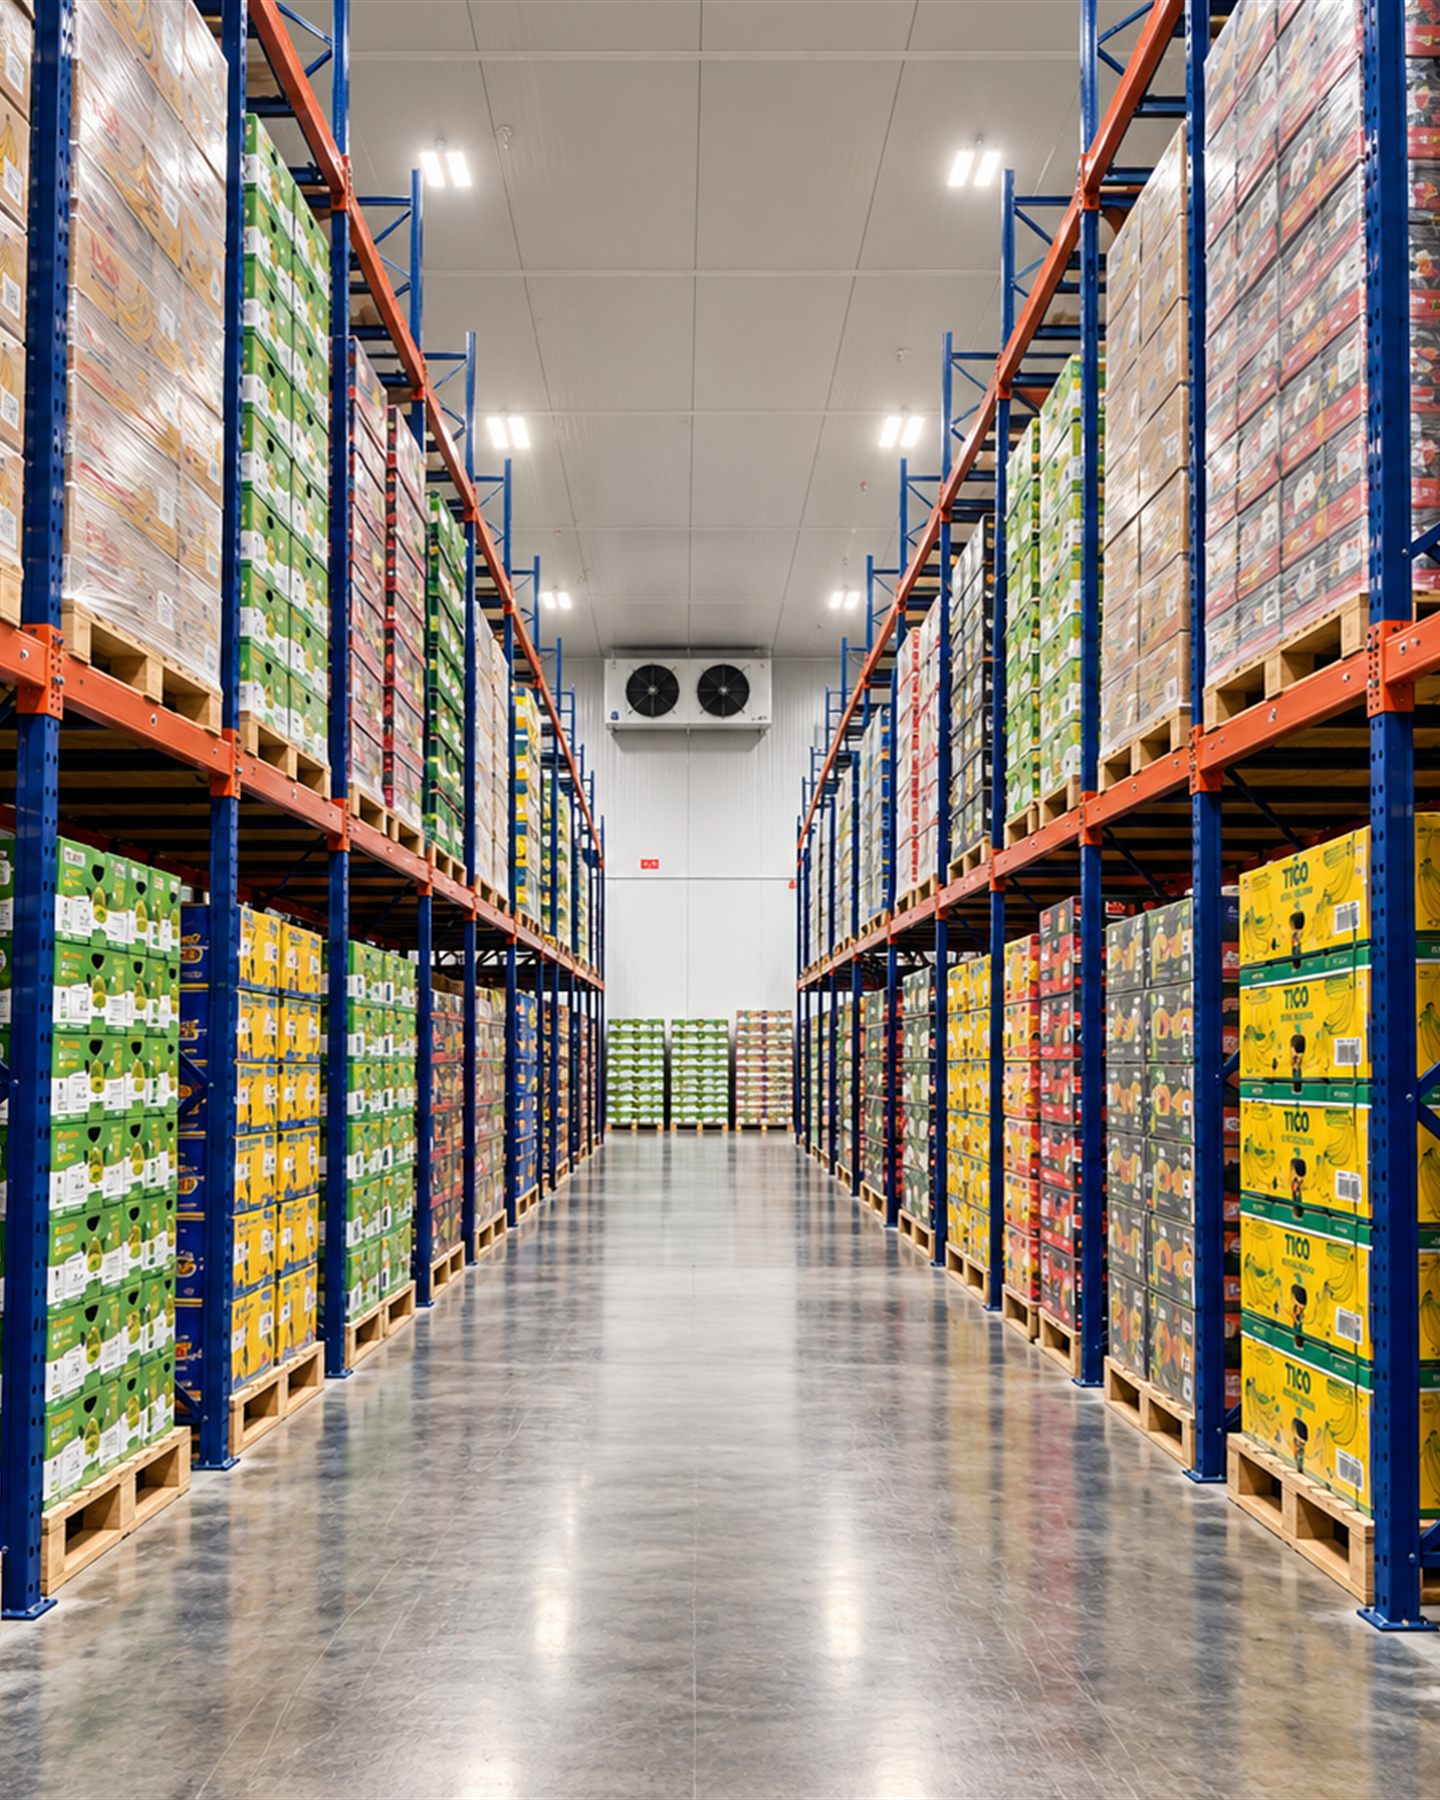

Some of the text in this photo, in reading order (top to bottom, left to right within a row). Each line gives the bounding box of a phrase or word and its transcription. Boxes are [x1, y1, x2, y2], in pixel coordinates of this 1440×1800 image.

[1282, 861, 1309, 888] TICO
[1284, 986, 1309, 1009] TICO
[1284, 1111, 1310, 1133] TICO
[1285, 1234, 1311, 1260] TICO
[1285, 1362, 1311, 1394] TICO
